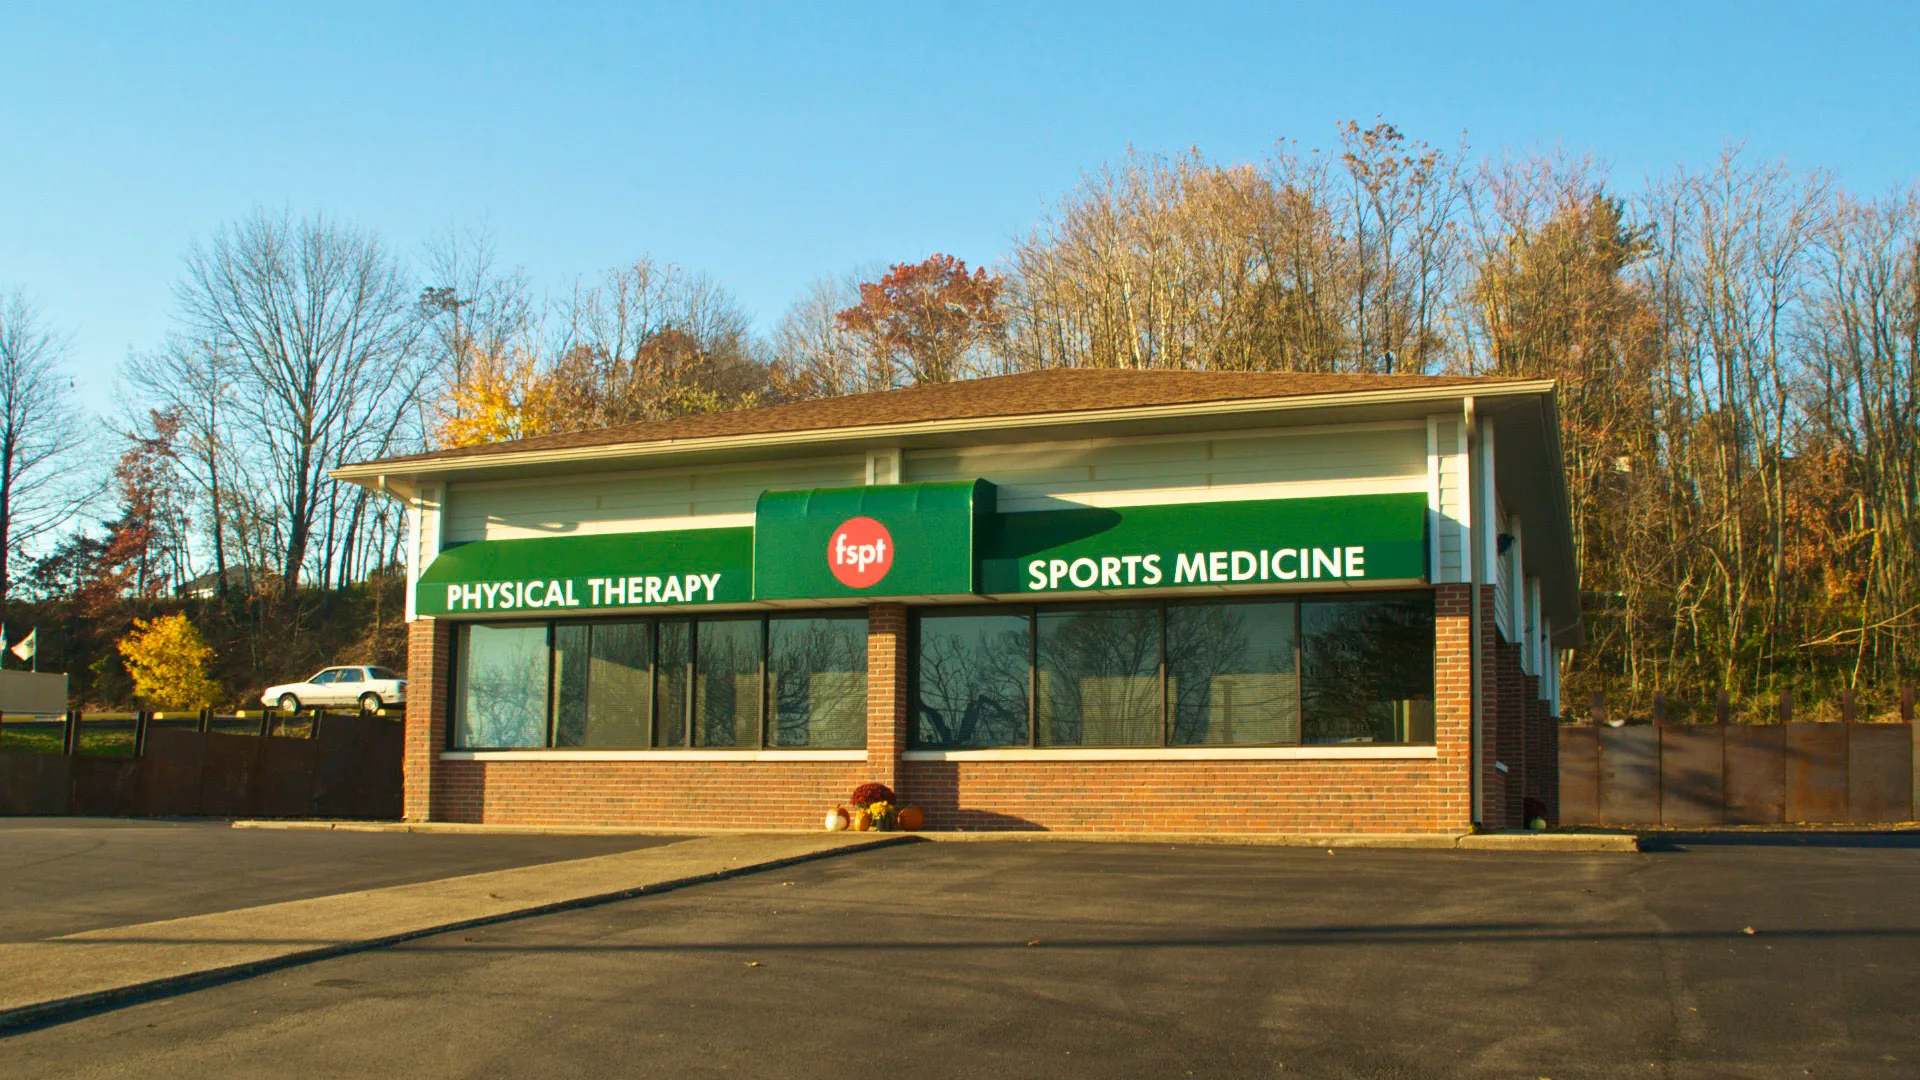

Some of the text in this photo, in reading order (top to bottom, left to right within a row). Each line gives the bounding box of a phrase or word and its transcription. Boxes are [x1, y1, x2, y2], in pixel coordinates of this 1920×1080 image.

[834, 532, 887, 574] fspt
[1028, 546, 1365, 591] SPORTS MEDICINE
[446, 573, 722, 611] PHYSICAL THERAPY
